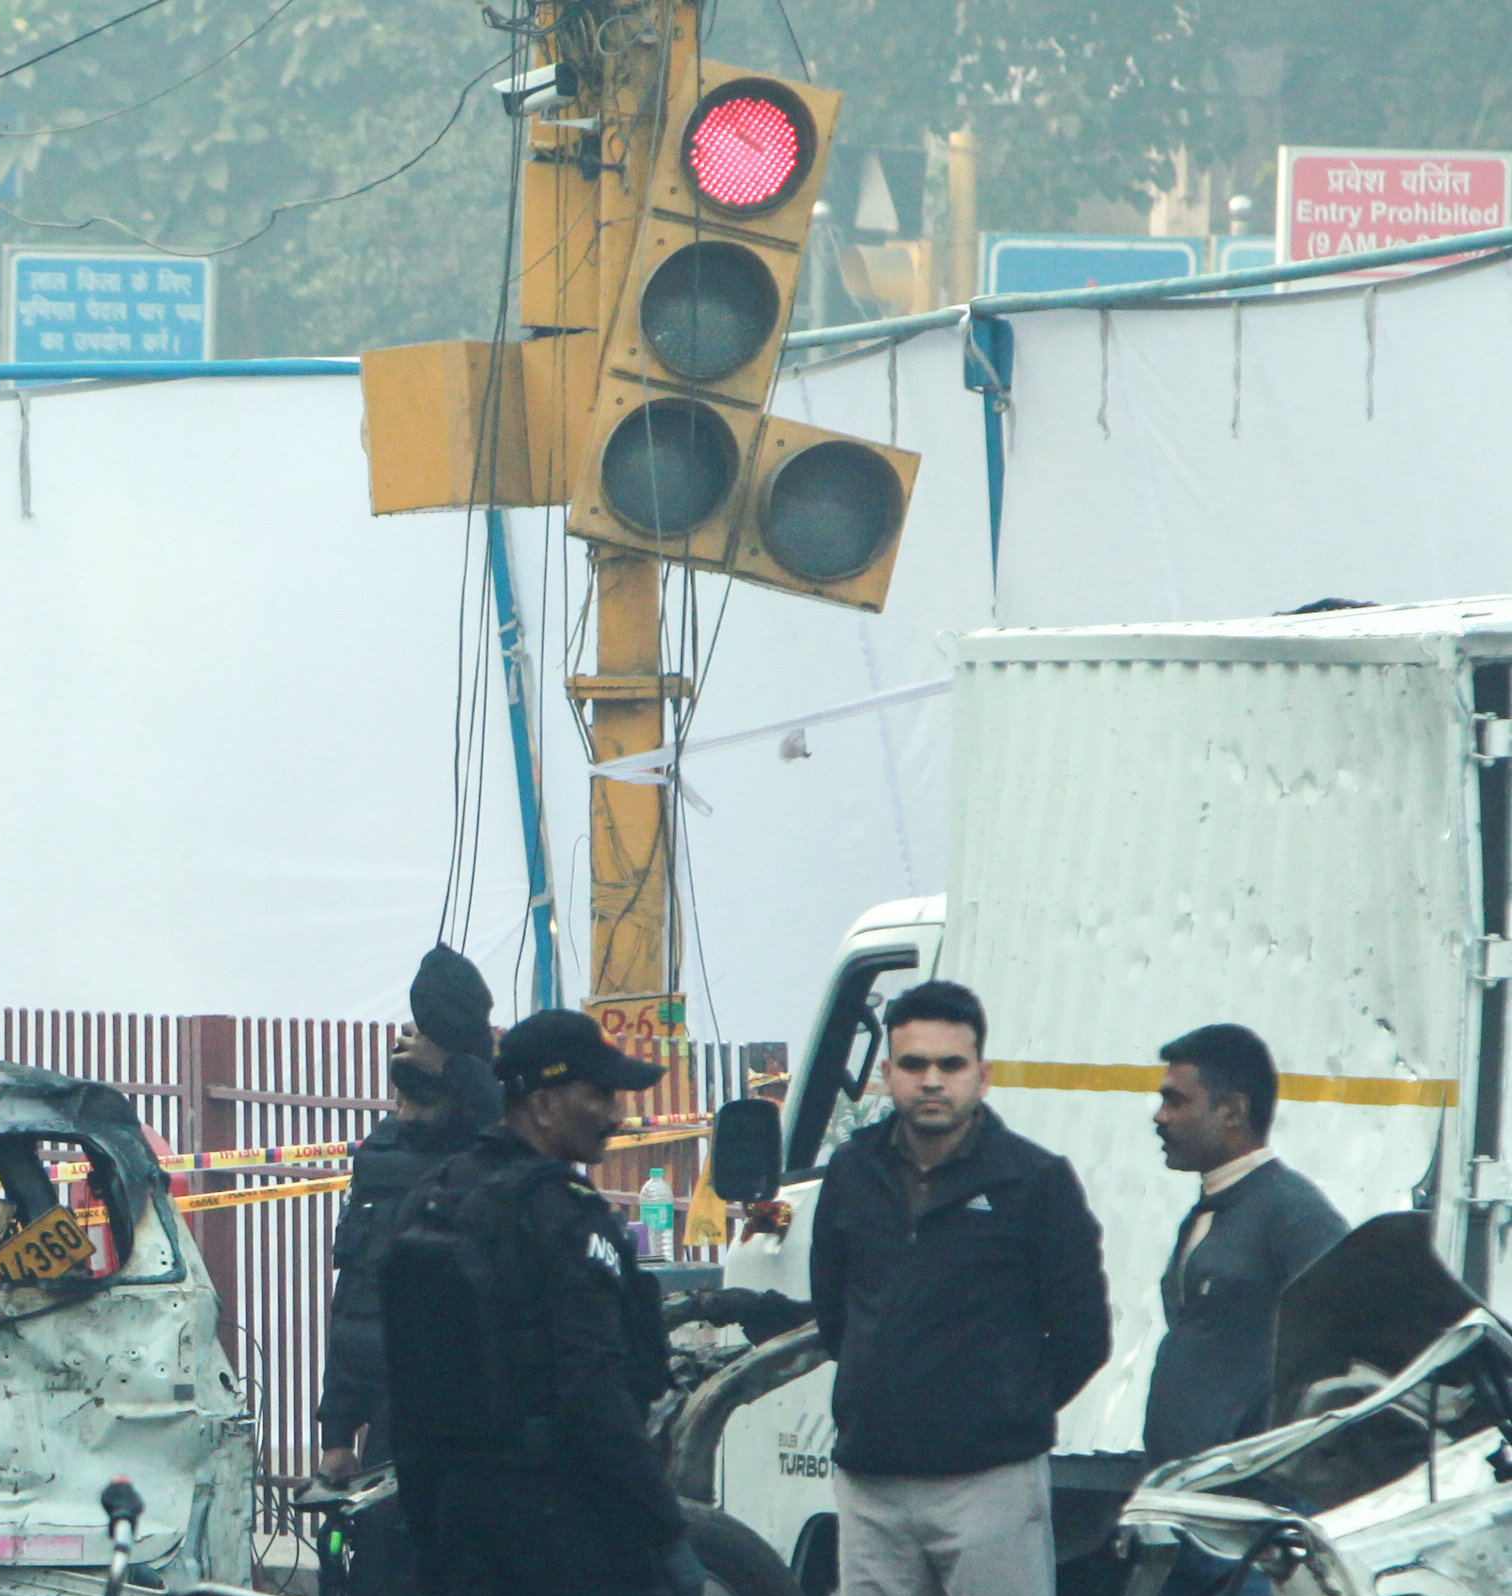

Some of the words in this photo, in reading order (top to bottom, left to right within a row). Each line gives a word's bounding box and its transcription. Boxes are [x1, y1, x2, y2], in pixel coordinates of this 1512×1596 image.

[1328, 161, 1386, 194] प्रवेश
[1400, 161, 1472, 195] वर्जित
[1297, 199, 1364, 229] Entry
[1370, 201, 1500, 225] Prohibited
[1336, 233, 1377, 253] AM
[294, 1144, 322, 1158] NOT
[327, 1142, 346, 1156] DO
[779, 1452, 829, 1479] TURBO
